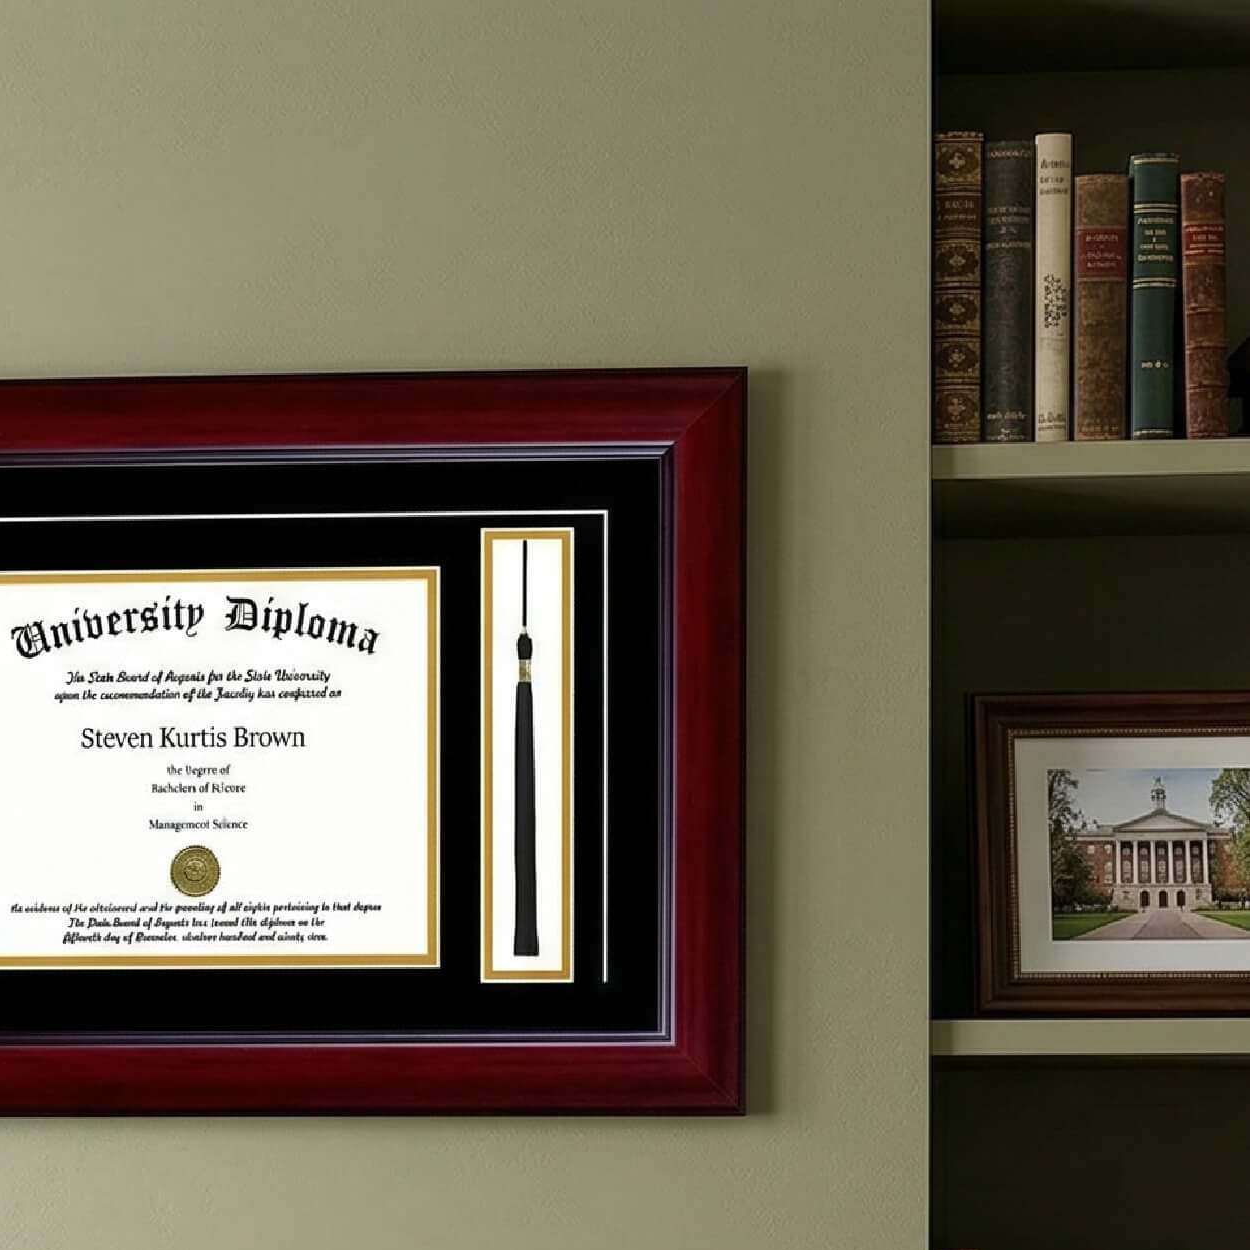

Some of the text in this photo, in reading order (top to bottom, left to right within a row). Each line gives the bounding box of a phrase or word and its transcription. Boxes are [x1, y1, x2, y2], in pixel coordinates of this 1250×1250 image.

[10, 594, 381, 659] University Diploma
[80, 725, 306, 750] Steven Kurtis Brown
[219, 763, 231, 776] of
[198, 782, 210, 793] of
[193, 801, 203, 812] in
